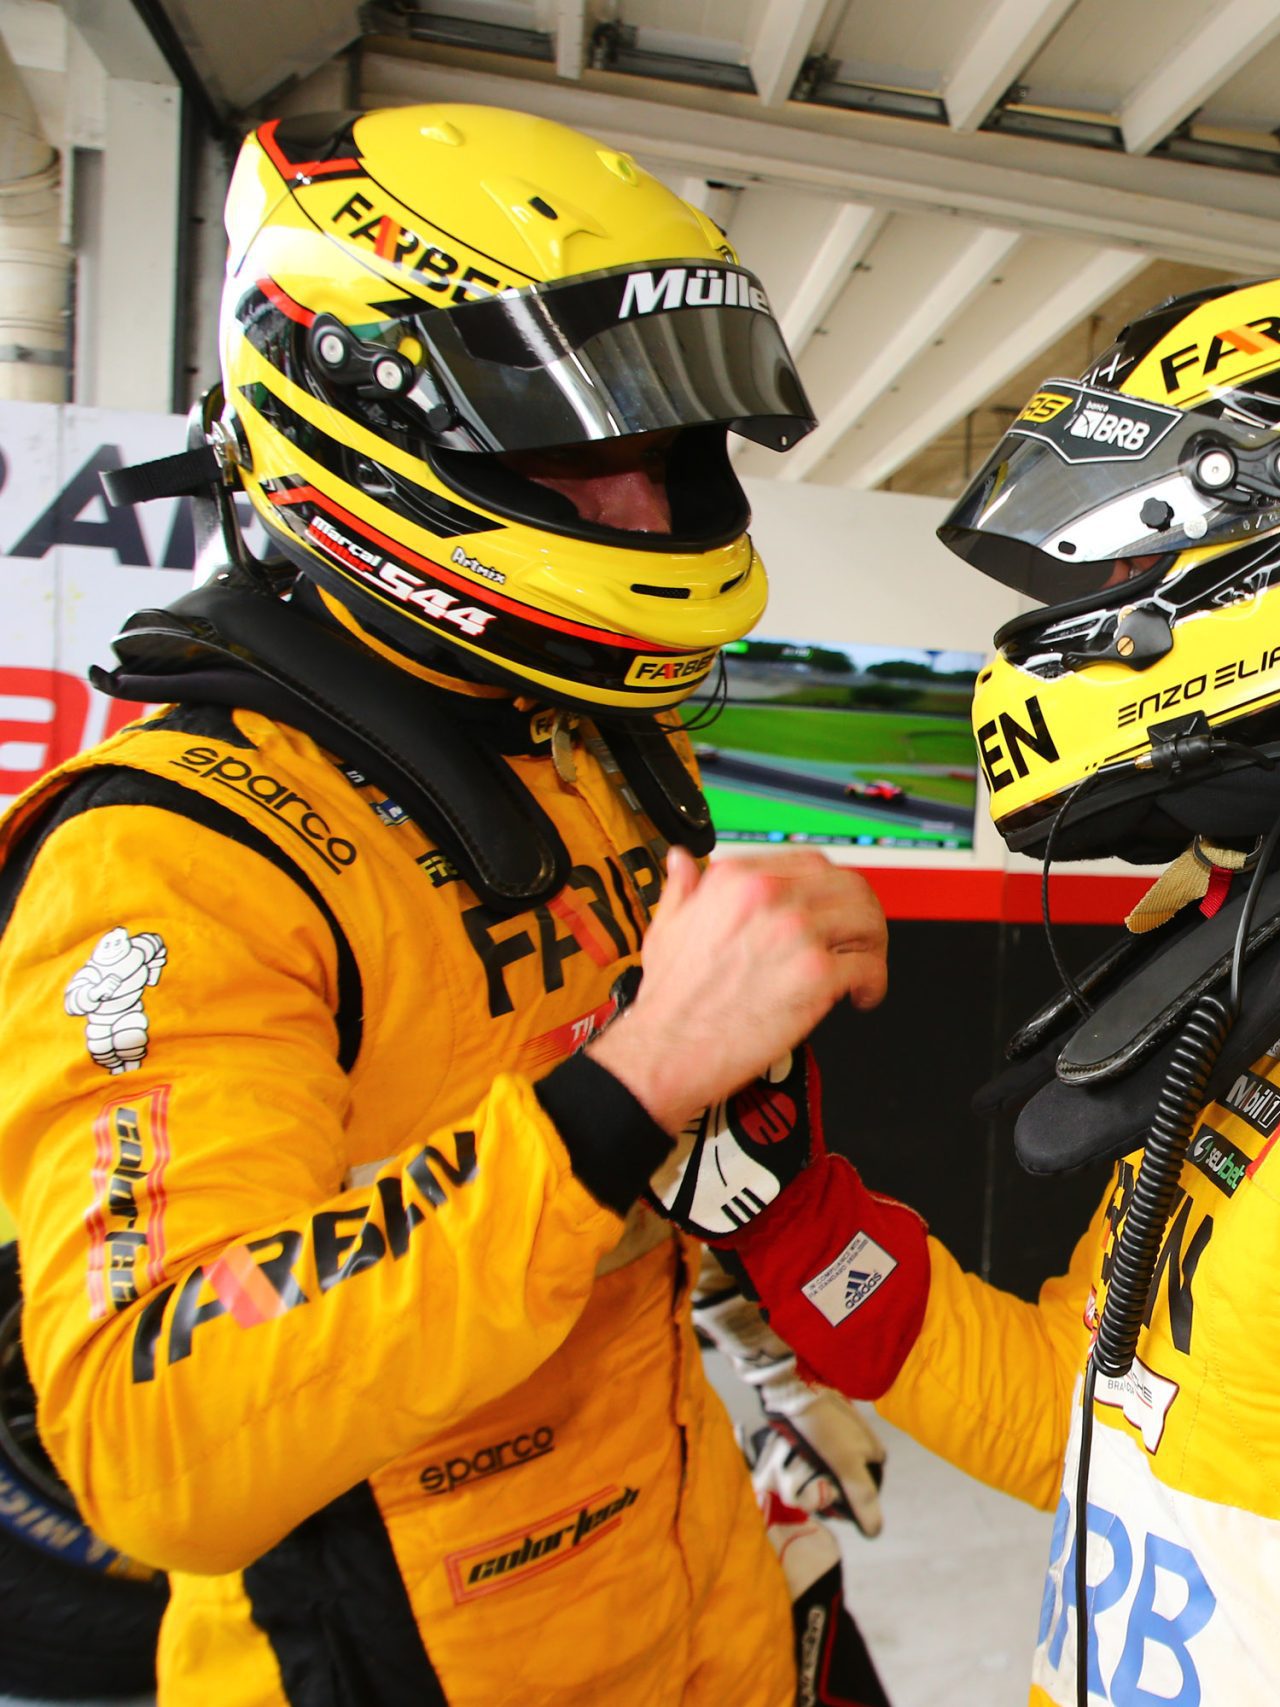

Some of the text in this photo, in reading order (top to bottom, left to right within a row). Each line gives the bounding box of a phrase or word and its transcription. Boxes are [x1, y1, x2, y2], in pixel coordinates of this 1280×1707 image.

[331, 192, 513, 304] FARBE
[1093, 412, 1151, 451] BRB
[975, 695, 1060, 795] EN
[179, 746, 357, 868] sparco
[1225, 1073, 1272, 1120] Mbil
[844, 1271, 883, 1310] adidas
[419, 1426, 555, 1492] sparco
